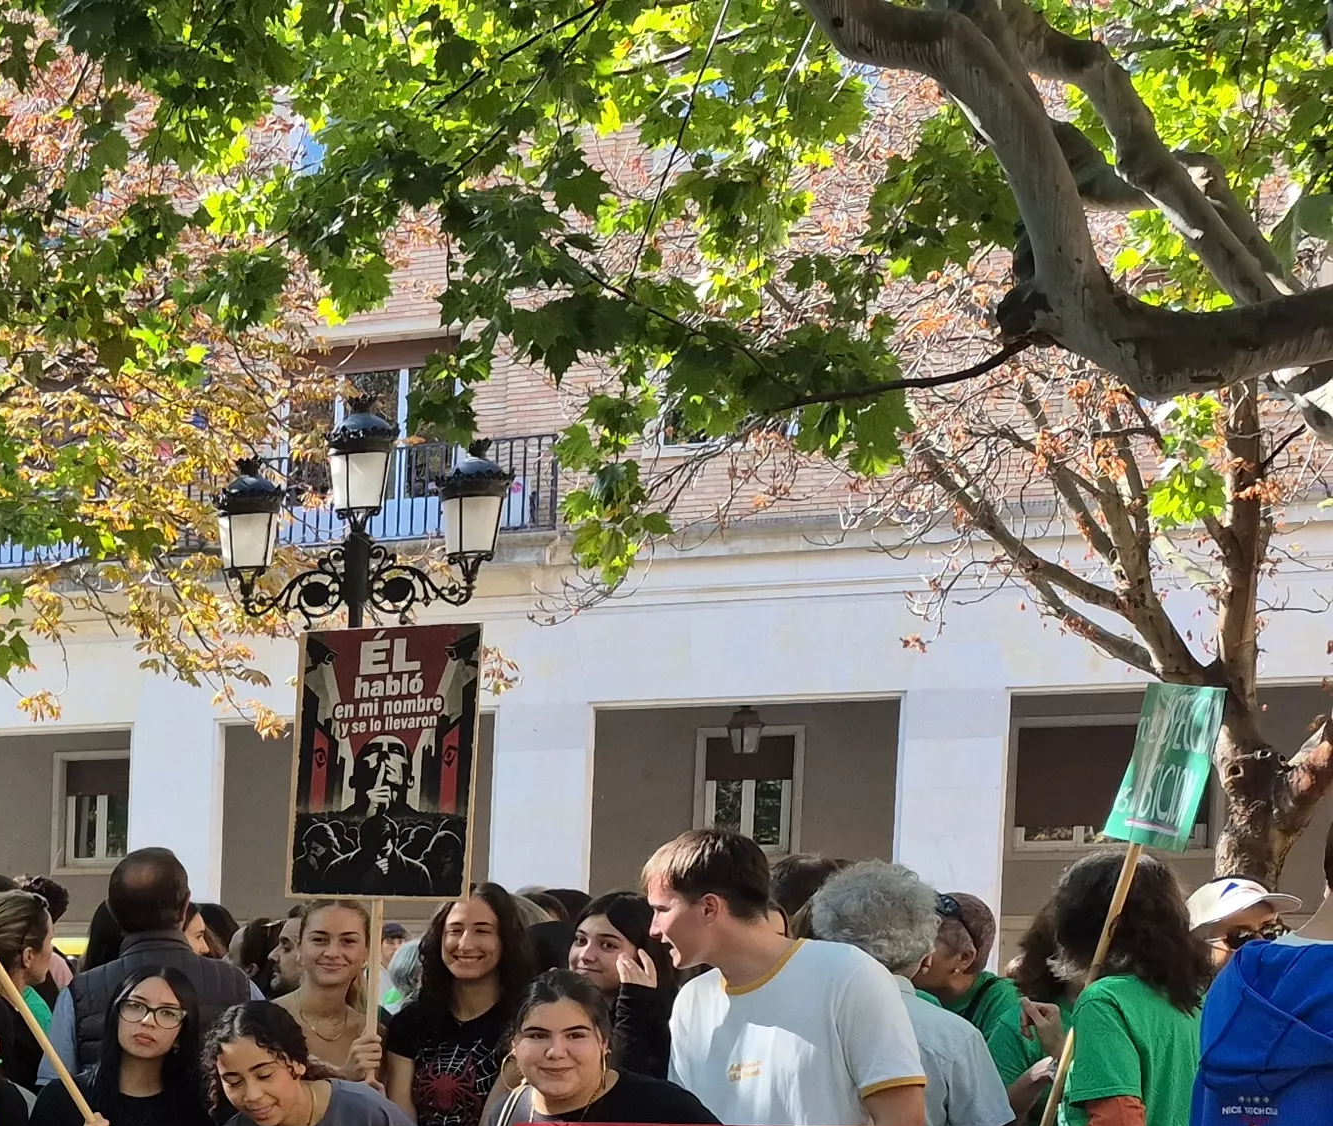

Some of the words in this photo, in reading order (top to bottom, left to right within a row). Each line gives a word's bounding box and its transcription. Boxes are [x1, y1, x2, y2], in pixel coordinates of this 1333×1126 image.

[359, 630, 421, 675] ÉL
[354, 672, 424, 699] habló
[334, 703, 354, 719] en
[358, 698, 379, 717] mi
[383, 694, 443, 715] nombre
[340, 722, 349, 738] y
[351, 721, 367, 734] se
[369, 718, 382, 732] lo
[385, 715, 438, 731] llevaron
